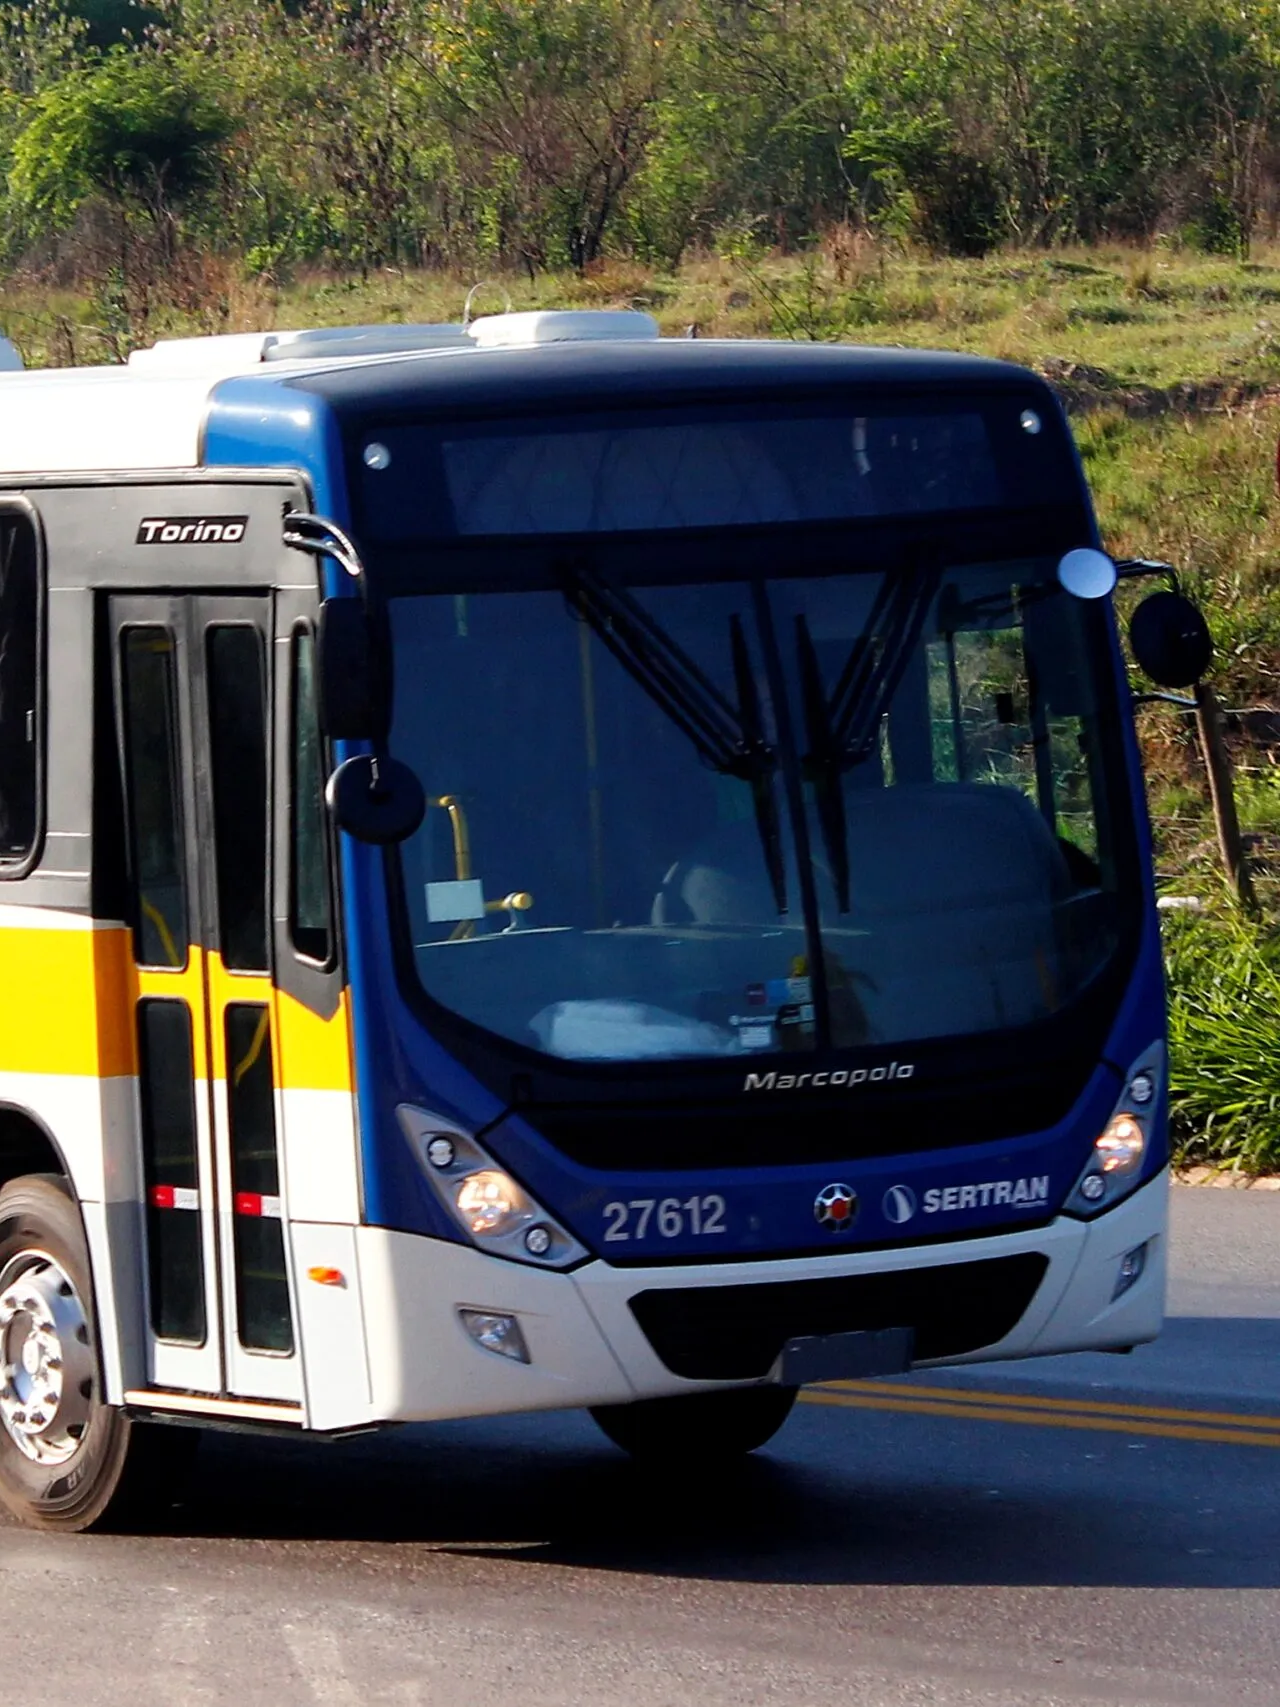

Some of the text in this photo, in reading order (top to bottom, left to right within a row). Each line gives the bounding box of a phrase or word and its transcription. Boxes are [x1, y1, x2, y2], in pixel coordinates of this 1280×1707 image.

[141, 520, 245, 542] Torino
[744, 1061, 915, 1091] Marcopolo
[923, 1175, 1049, 1213] SERTRAN
[602, 1195, 727, 1242] 27612
